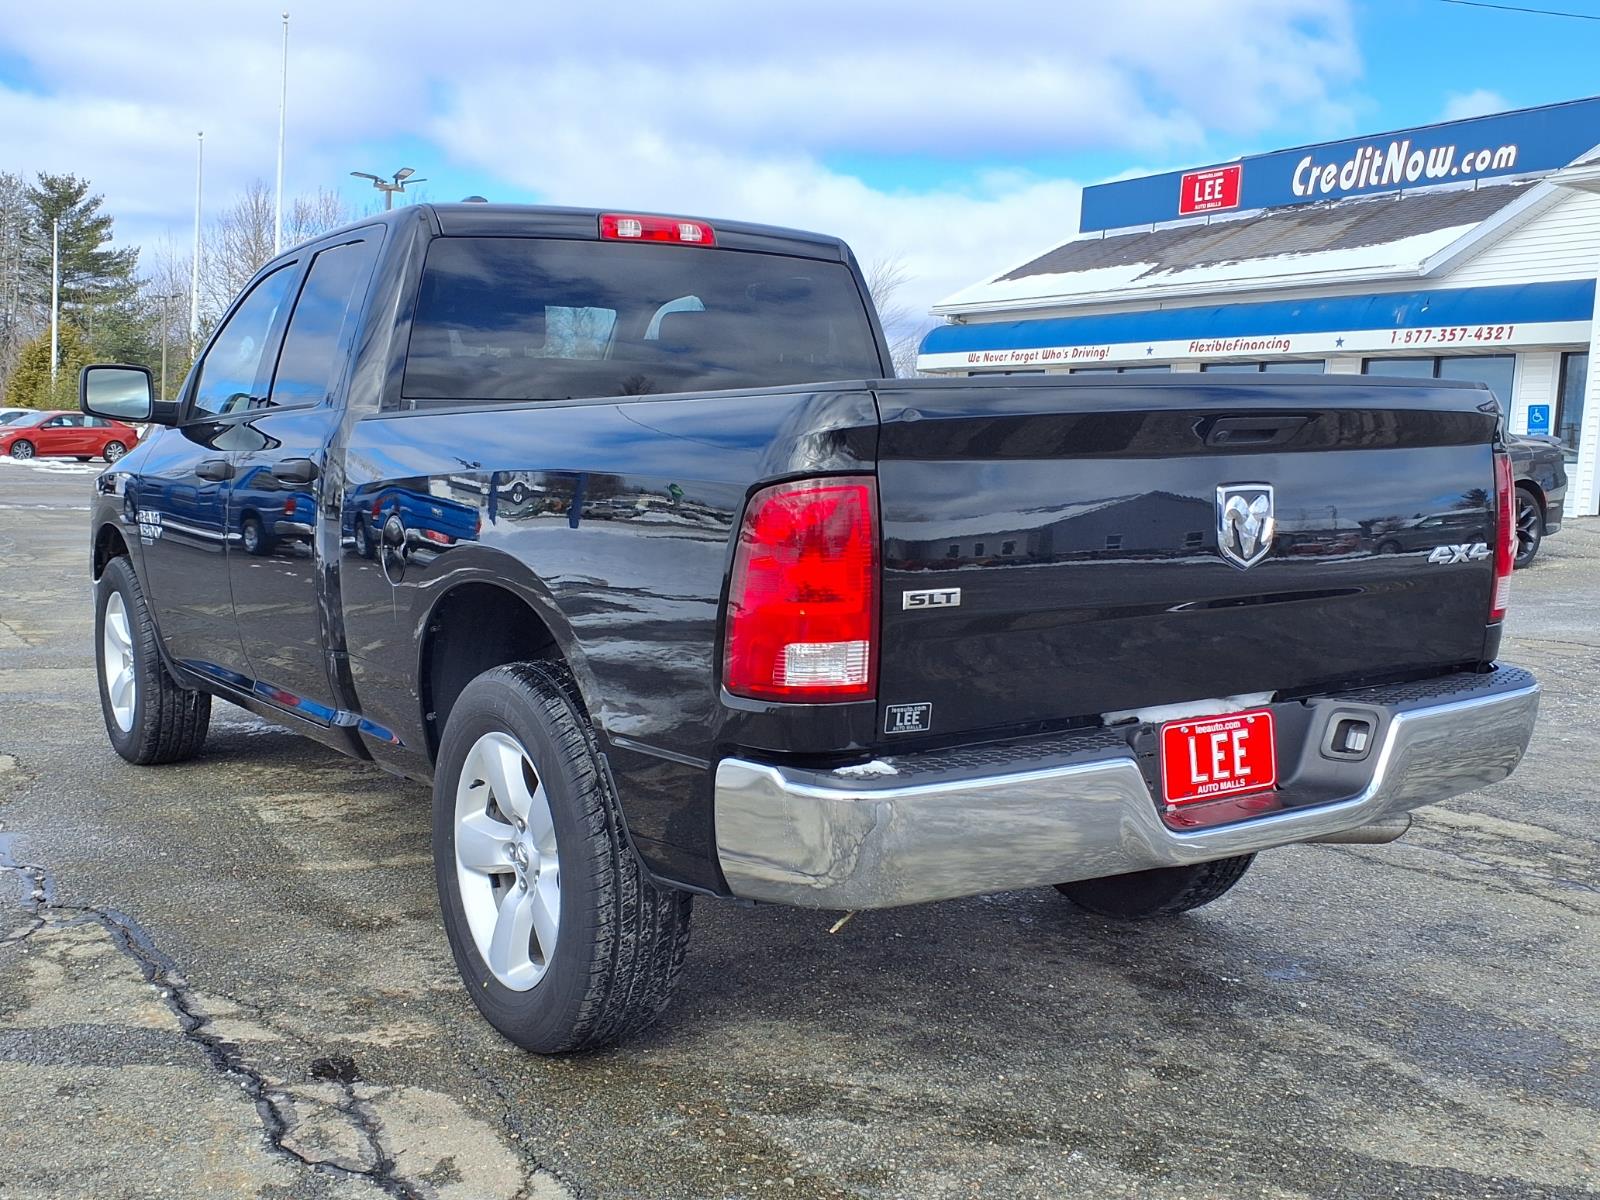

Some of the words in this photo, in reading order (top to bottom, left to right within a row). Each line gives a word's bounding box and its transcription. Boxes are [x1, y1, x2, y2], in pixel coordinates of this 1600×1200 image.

[1292, 140, 1517, 197] CreditNow.com
[1194, 178, 1225, 203] LEE
[1391, 326, 1514, 344] 1-877-357-4321
[967, 353, 981, 363] We
[982, 352, 1008, 362] Never
[1010, 351, 1039, 364] Forget
[1042, 349, 1069, 360] Who's
[1071, 346, 1111, 361] Driving!
[909, 592, 957, 606] SLT
[896, 711, 921, 726] LEE
[1195, 721, 1241, 734] leeauto.com
[1188, 728, 1251, 784] LEE
[1197, 784, 1219, 794] AUTO
[1219, 778, 1246, 791] MALLS
